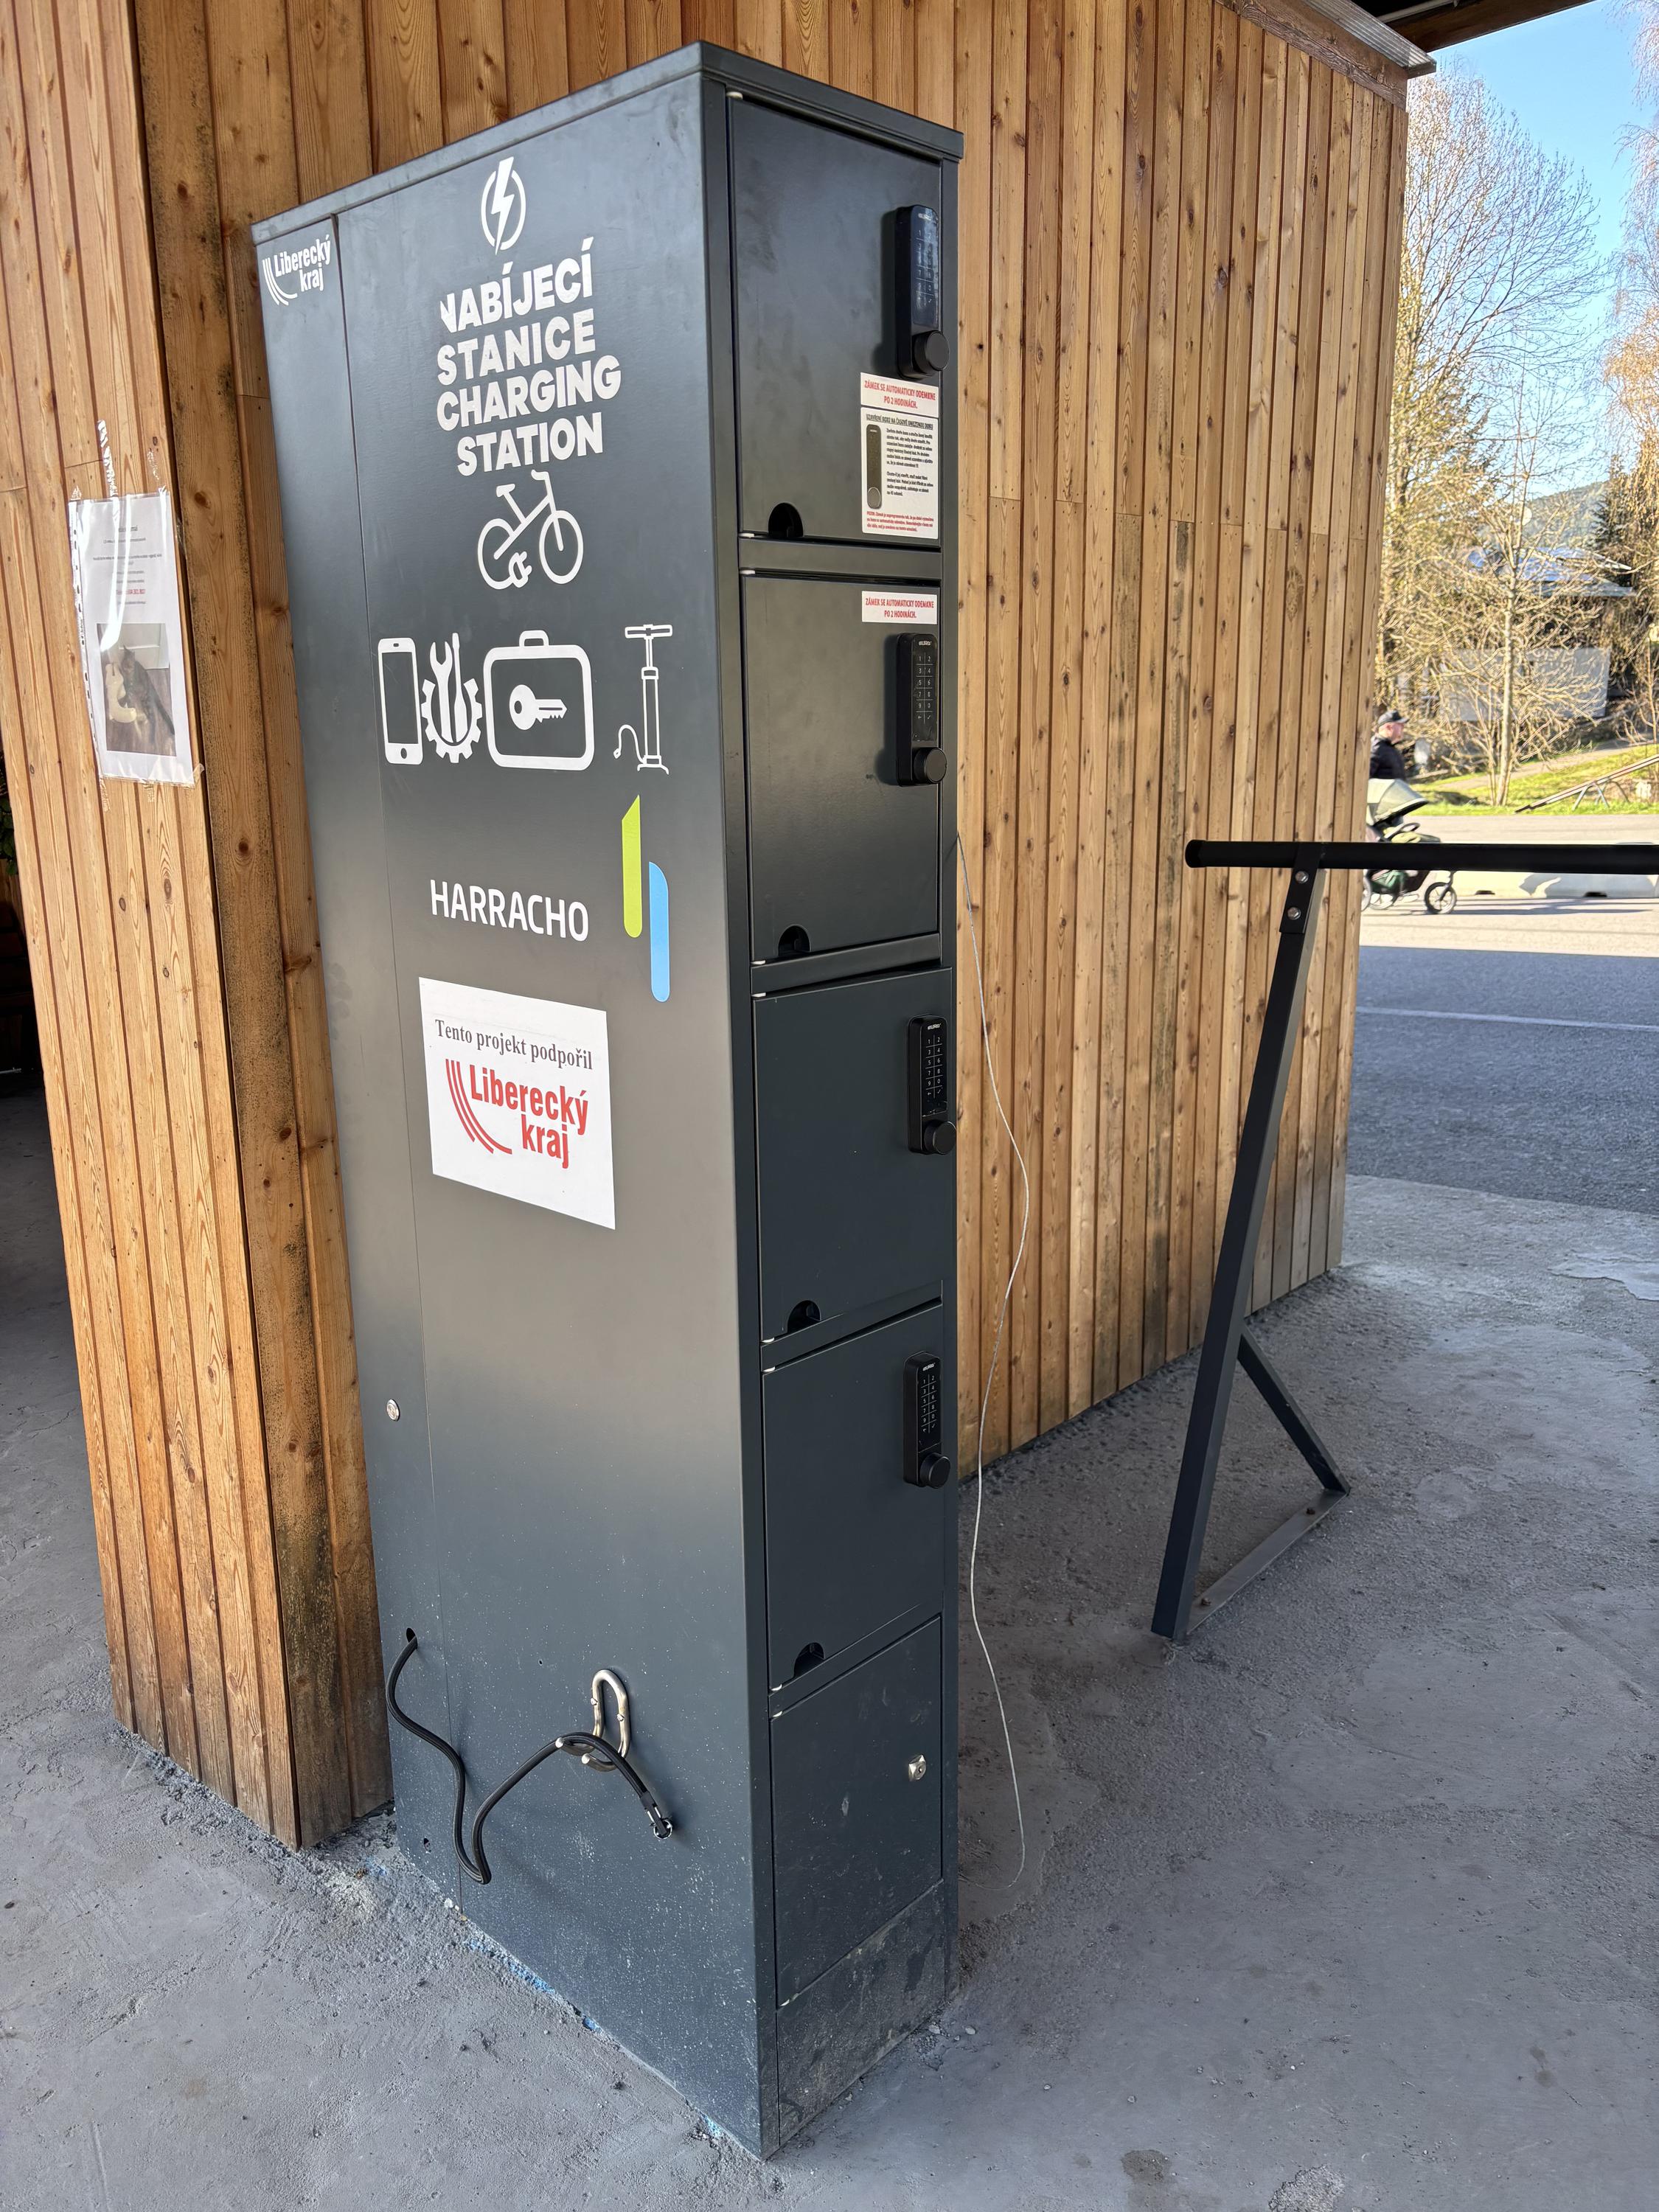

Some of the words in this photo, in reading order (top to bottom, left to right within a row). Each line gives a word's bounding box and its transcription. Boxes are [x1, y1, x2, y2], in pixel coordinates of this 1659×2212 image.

[274, 234, 331, 277] Liberecký
[299, 262, 324, 292] kraj
[440, 236, 594, 333] NABÍJECÍ
[437, 308, 596, 385] STANICE
[437, 355, 622, 431] CHARGING
[880, 383, 885, 392] SE
[886, 385, 915, 396] AUTOMATICKY
[884, 396, 890, 404] PO
[457, 412, 603, 476] STATION
[865, 597, 880, 606] ZÁMEK
[886, 599, 914, 607] AUTOMATICKY
[430, 879, 588, 942] HARRACHO
[435, 1019, 472, 1043] Tento
[477, 1032, 526, 1055] projekt
[531, 1044, 593, 1070] podpořil
[469, 1064, 588, 1135] Liberecký
[521, 1113, 569, 1169] kraj
